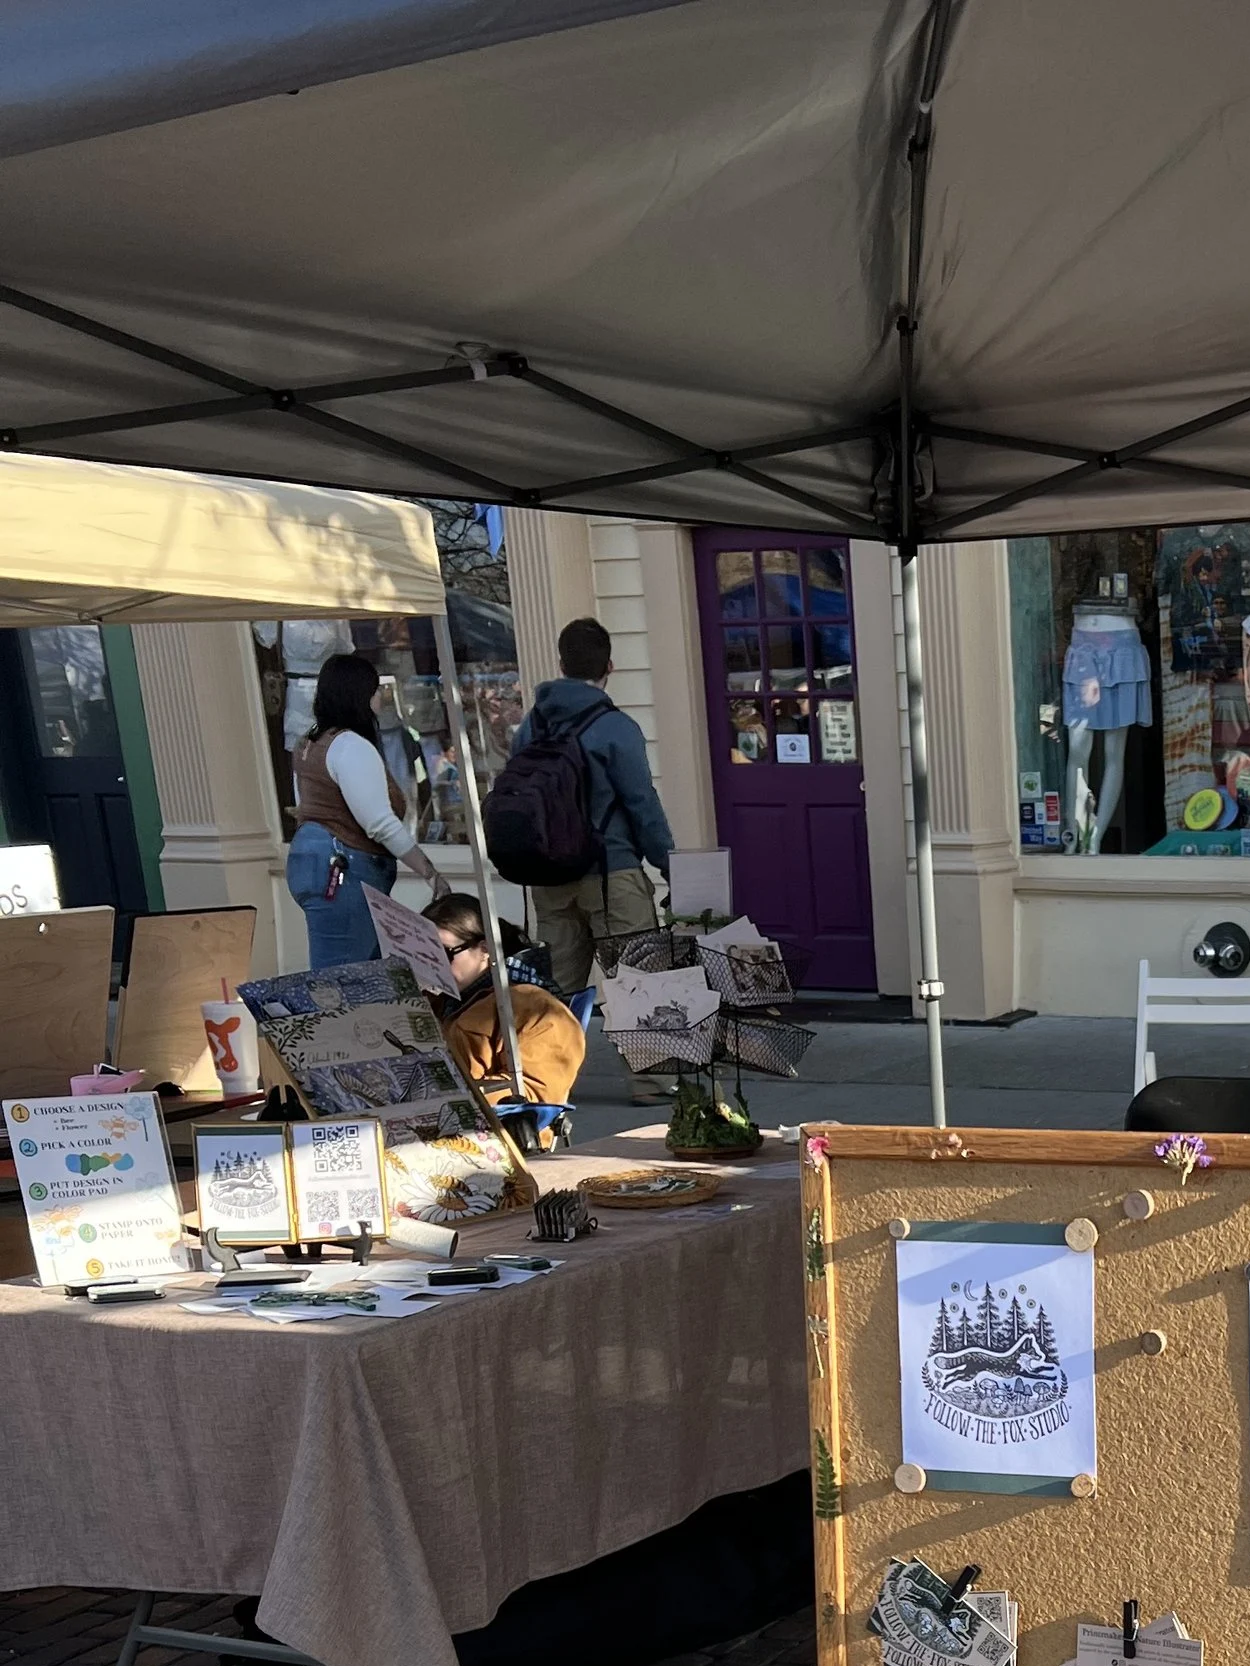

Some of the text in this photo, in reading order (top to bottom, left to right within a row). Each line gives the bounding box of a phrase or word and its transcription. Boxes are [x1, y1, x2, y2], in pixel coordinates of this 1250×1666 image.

[33, 1102, 125, 1117] CHOOSE DESIGN
[41, 1138, 112, 1151] PICK COLOR
[50, 1178, 110, 1190] PUT DESIGN
[52, 1187, 108, 1200] COLOR PAD
[924, 1393, 1070, 1445] FOLLOW THE FOX STUDIO
[1081, 1627, 1124, 1642] Printmake
[909, 1639, 928, 1662] THE
